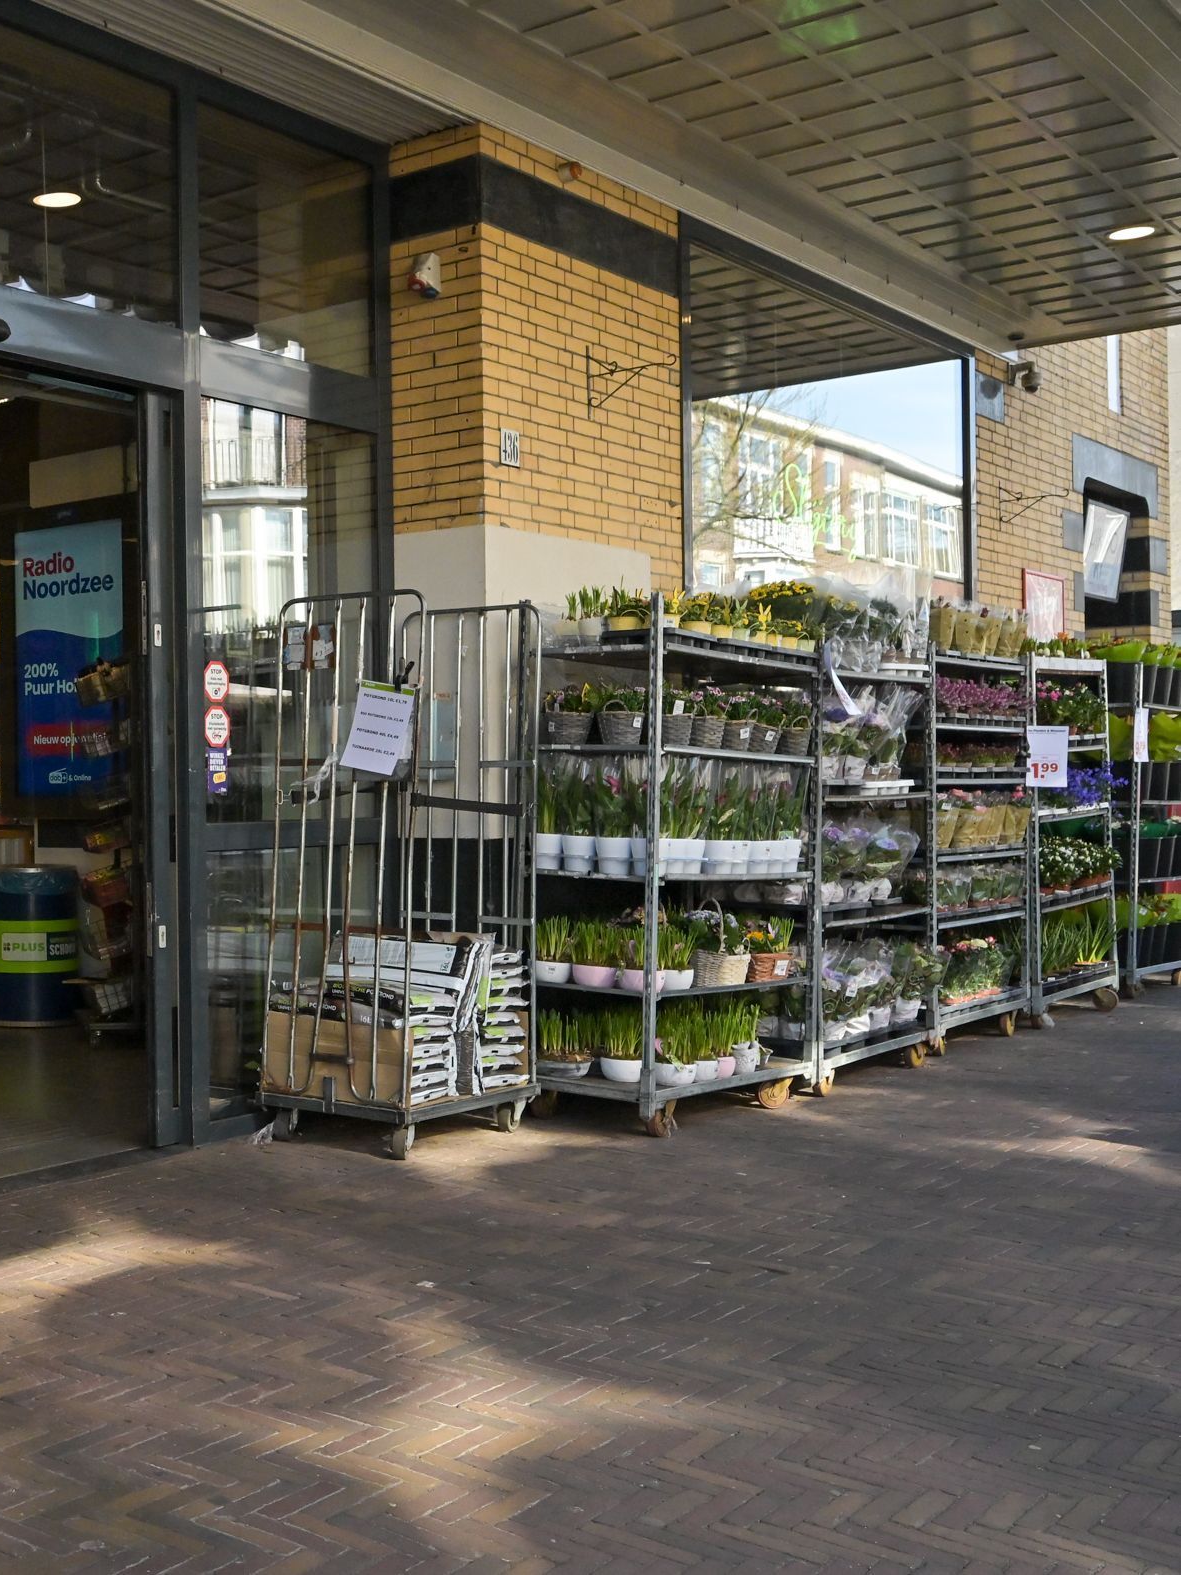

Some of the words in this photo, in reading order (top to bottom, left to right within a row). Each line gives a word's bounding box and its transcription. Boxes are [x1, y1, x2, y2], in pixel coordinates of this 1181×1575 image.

[502, 431, 519, 465] 436
[22, 551, 75, 578] Radio
[23, 573, 114, 600] Noordzee
[24, 662, 59, 679] 200%
[24, 681, 55, 696] Puur
[33, 732, 59, 745] Nieuw
[60, 735, 70, 747] op
[73, 774, 92, 782] Online
[1030, 762, 1059, 779] 1.99
[12, 942, 45, 952] PLUS
